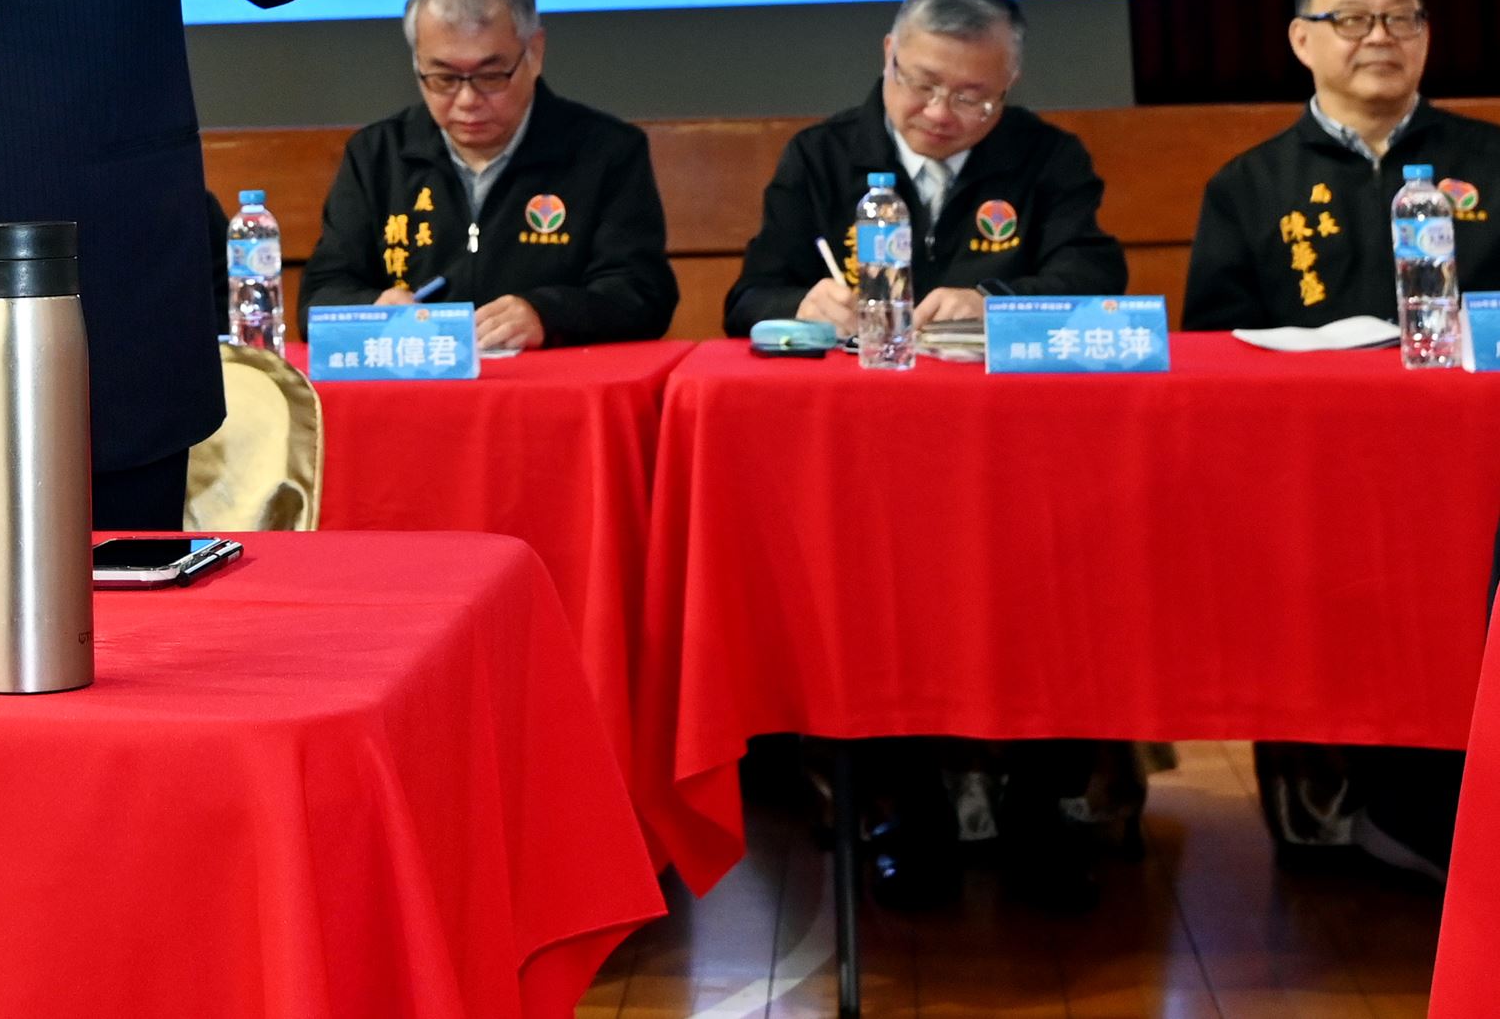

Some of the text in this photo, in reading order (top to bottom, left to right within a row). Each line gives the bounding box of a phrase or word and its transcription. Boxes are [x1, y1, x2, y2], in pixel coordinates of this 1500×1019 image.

[364, 336, 457, 368] 賴偉君
[1047, 326, 1152, 360] 李忠萍
